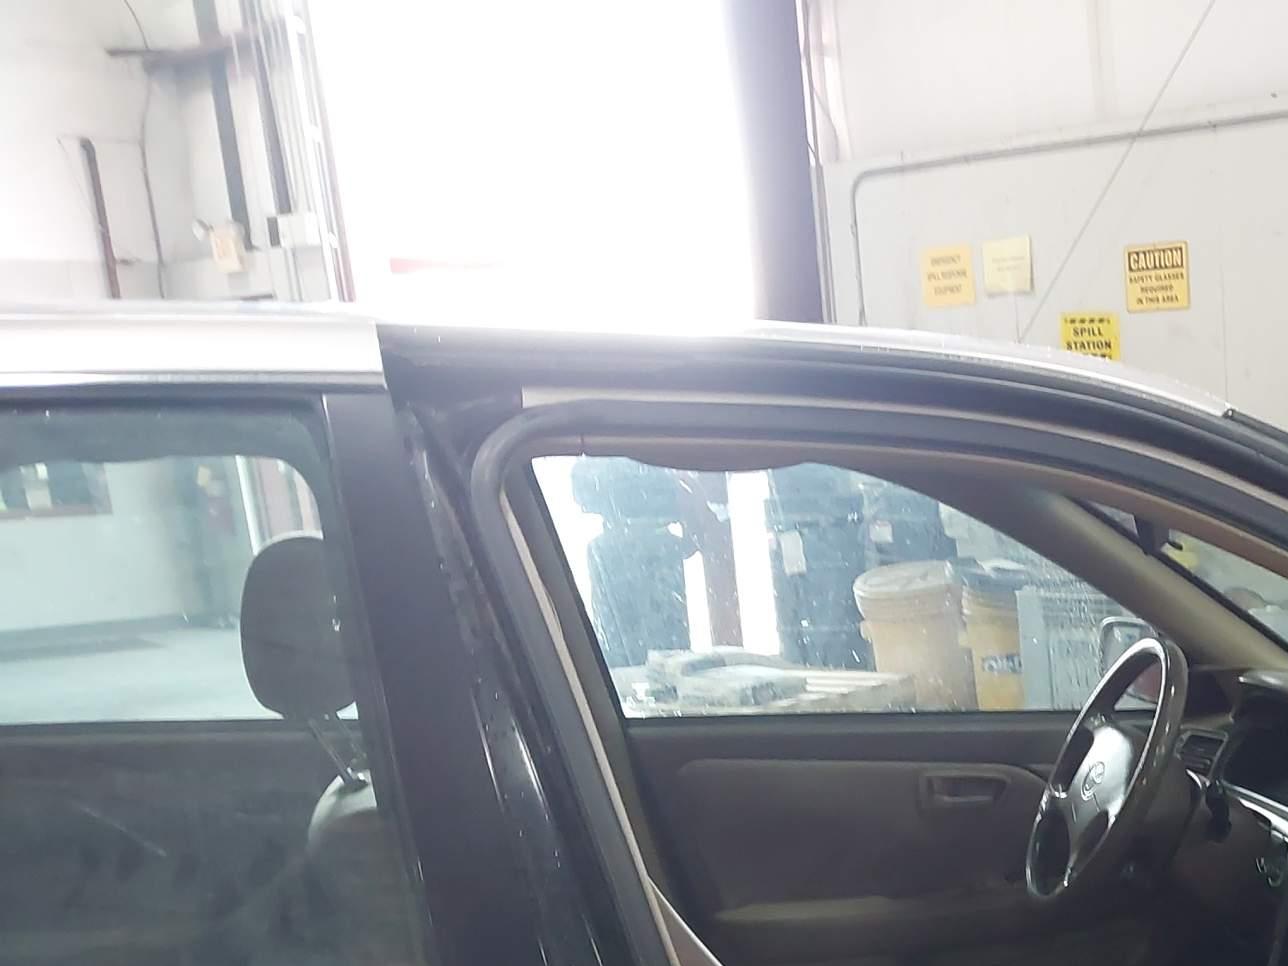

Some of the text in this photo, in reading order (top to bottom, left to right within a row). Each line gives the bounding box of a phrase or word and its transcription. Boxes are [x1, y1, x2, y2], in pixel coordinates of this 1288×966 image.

[1129, 247, 1182, 271] CAUTION
[1072, 327, 1104, 337] SPILL
[1066, 340, 1112, 350] STATION
